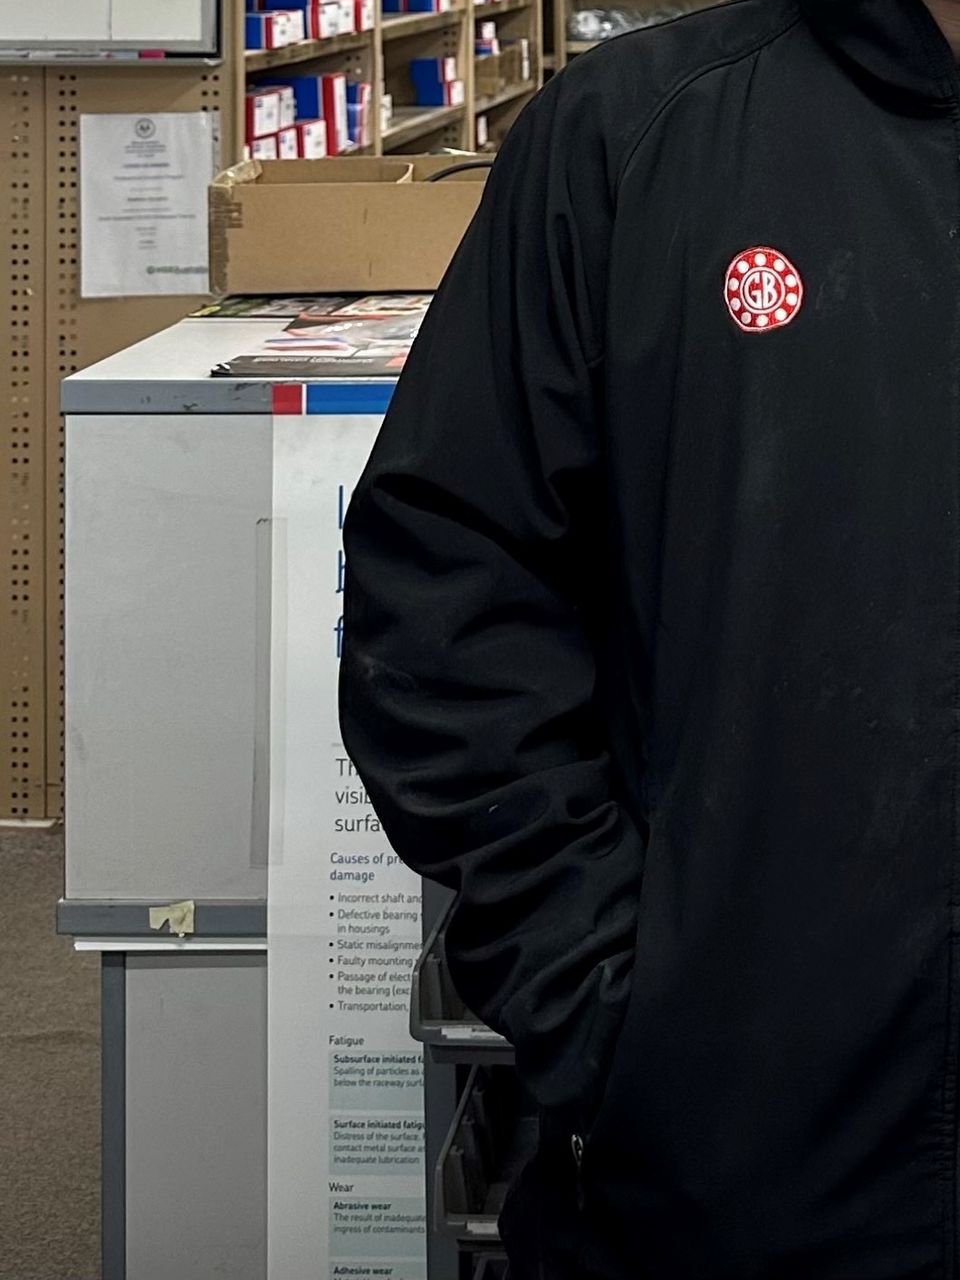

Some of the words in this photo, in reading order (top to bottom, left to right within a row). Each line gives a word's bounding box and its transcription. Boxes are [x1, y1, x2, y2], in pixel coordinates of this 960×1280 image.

[743, 271, 778, 310] GB
[335, 758, 359, 776] Th
[335, 814, 381, 832] surfa
[330, 852, 370, 864] Causes
[372, 853, 384, 864] of
[330, 870, 375, 883] damage
[338, 892, 379, 903] Incorrect
[381, 893, 404, 903] shaft
[338, 909, 380, 920] Defective
[382, 910, 418, 922] bearing
[337, 924, 346, 933] in
[348, 924, 390, 936] housings
[337, 940, 364, 950] Static
[337, 956, 366, 967] Faulty
[368, 958, 413, 968] mounting
[338, 972, 376, 982] Passage
[377, 972, 387, 981] of
[389, 972, 411, 981] elect
[337, 986, 353, 995] the
[355, 986, 390, 997] bearing
[329, 1035, 365, 1047] Fatigue
[334, 1054, 380, 1064] Subsurface
[382, 1054, 416, 1064] initiated
[334, 1119, 366, 1129] Surface
[367, 1119, 401, 1129] initiated
[329, 1182, 354, 1193] Wear
[334, 1202, 369, 1210] Abrasive
[334, 1266, 370, 1275] Adhesive
